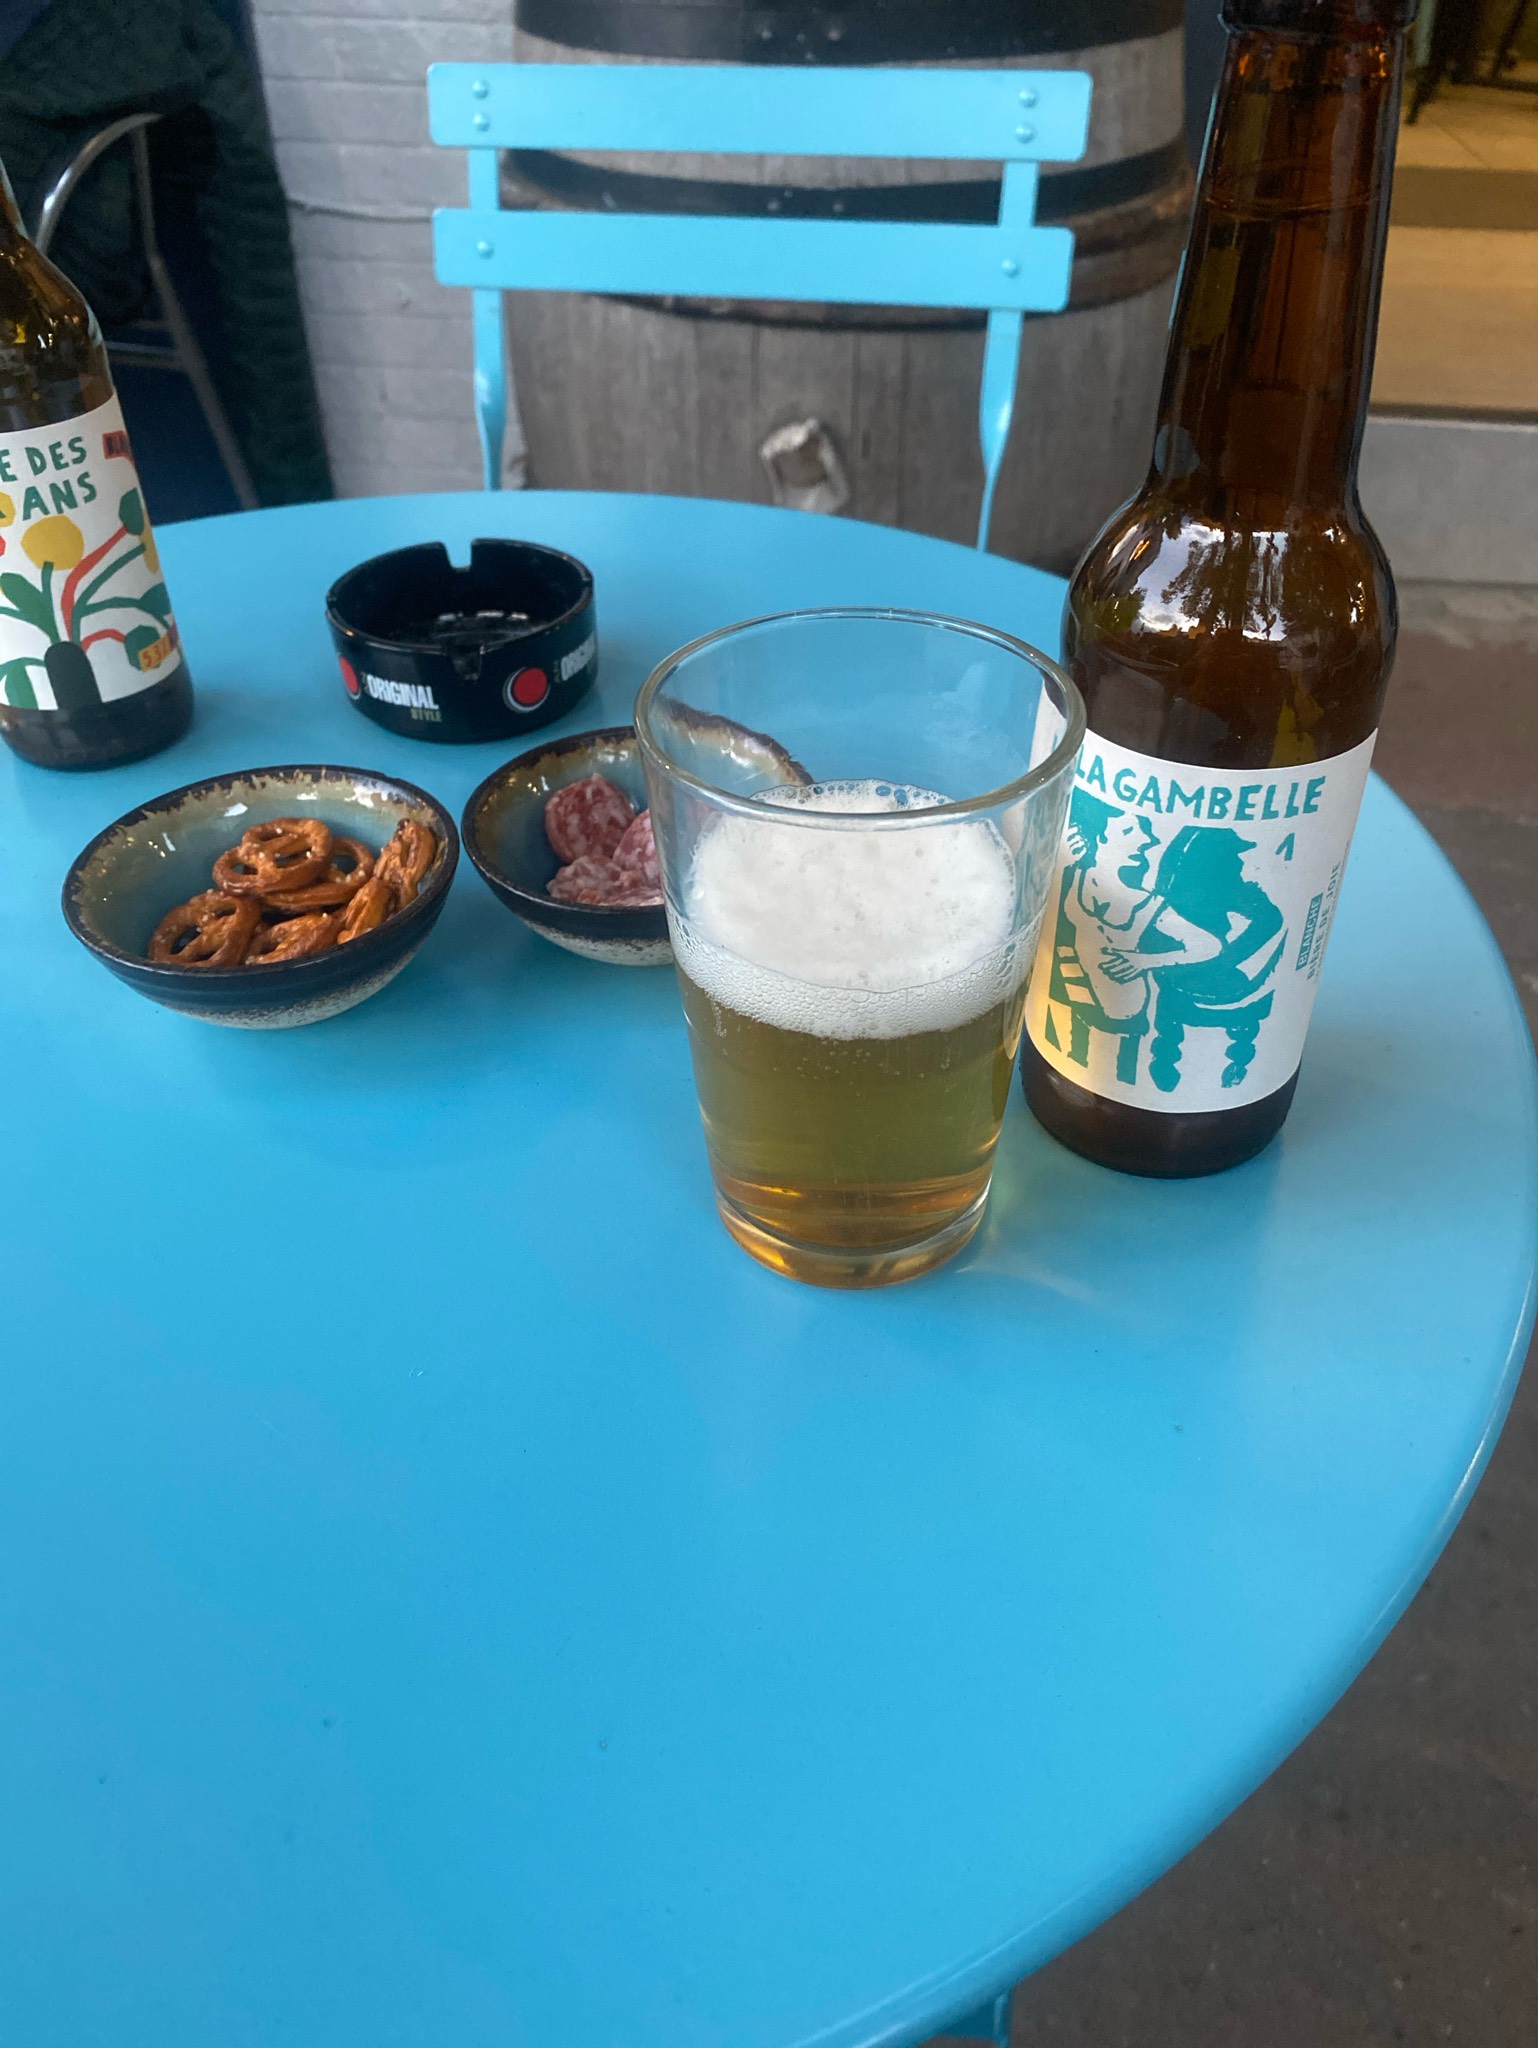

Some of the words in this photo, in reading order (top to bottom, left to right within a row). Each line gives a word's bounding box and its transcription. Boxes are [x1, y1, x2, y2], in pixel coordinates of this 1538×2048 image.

[25, 436, 87, 476] DES
[22, 471, 97, 521] ANS
[366, 674, 439, 710] ORIGINAL
[411, 708, 442, 722] STYLE
[1113, 768, 1326, 821] GAMBELLE
[1275, 832, 1295, 861] 1
[1319, 905, 1330, 929] DE
[1326, 861, 1341, 899] JOIE
[1297, 895, 1322, 967] BLANCHE
